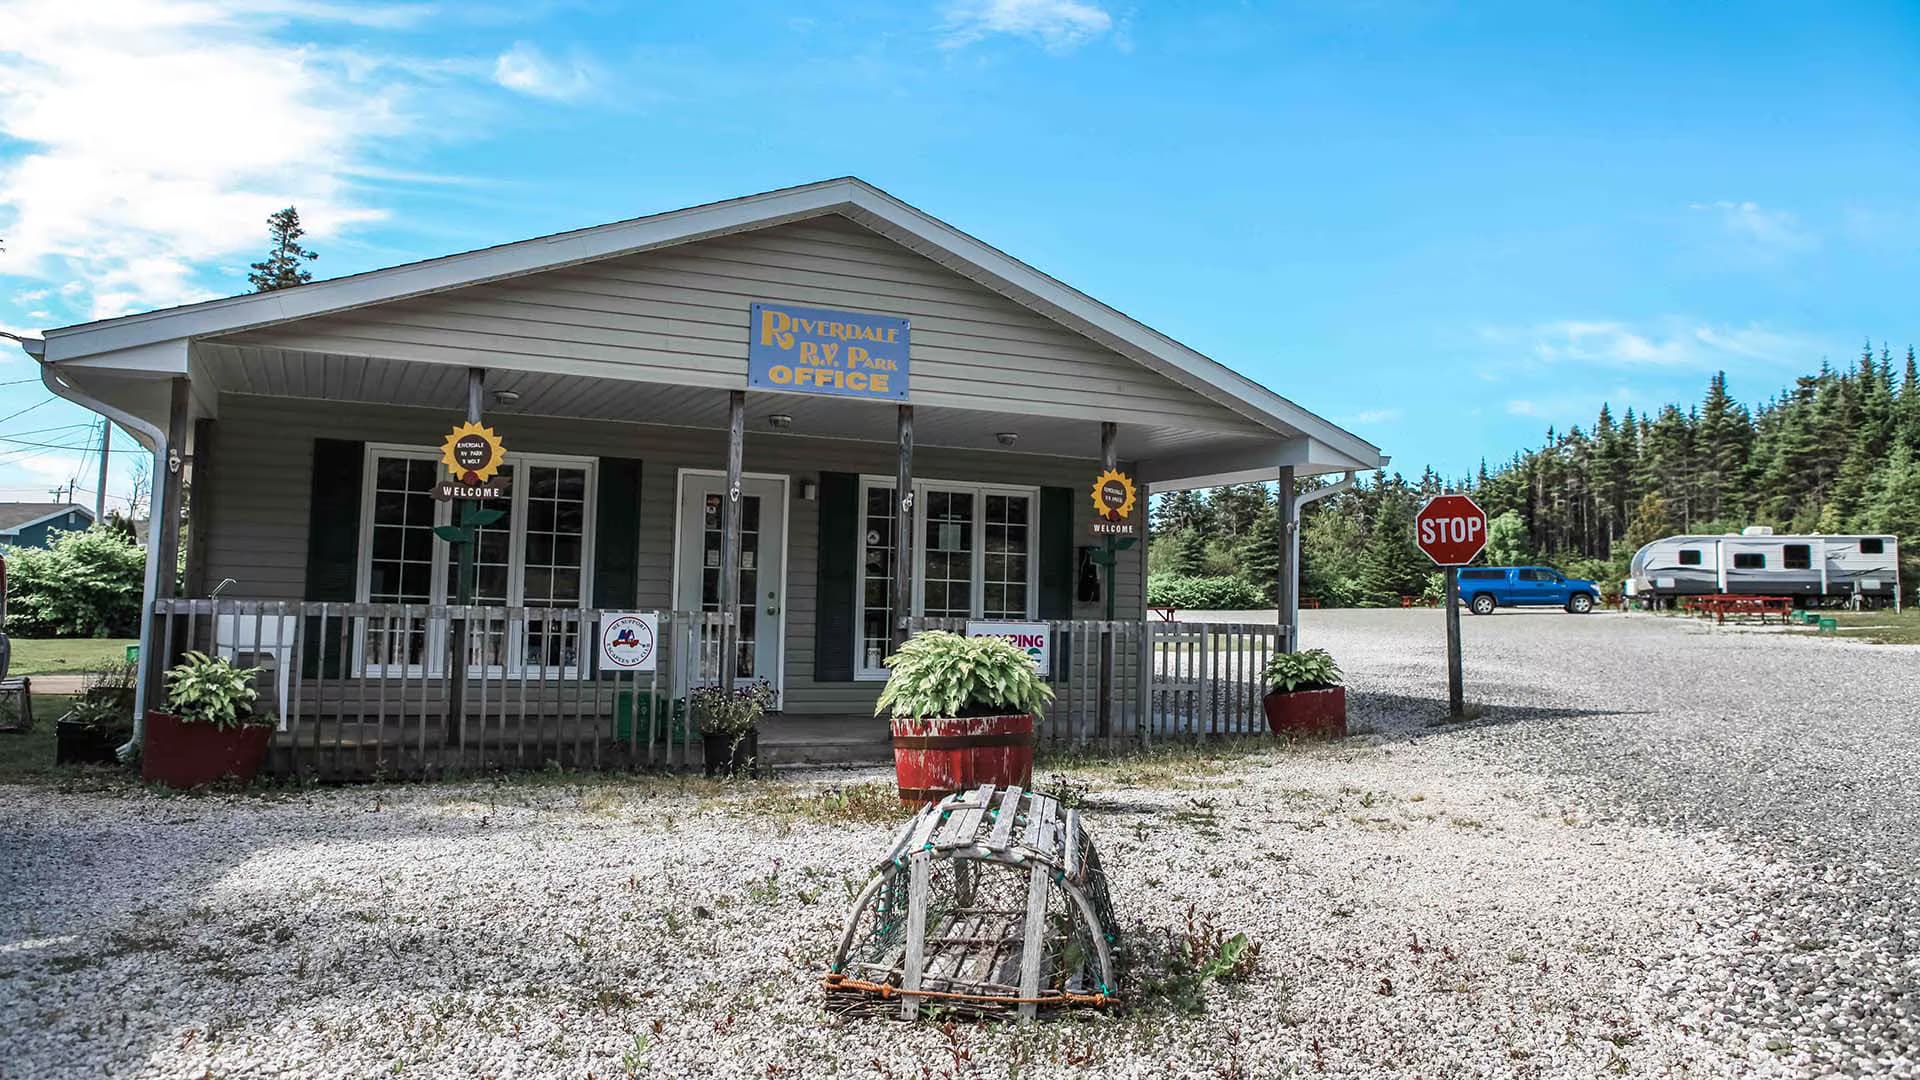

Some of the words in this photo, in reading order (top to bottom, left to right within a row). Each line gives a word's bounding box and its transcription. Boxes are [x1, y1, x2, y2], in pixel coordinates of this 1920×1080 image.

[768, 365, 889, 392] OFFICE
[443, 486, 500, 497] WELCOME
[1093, 524, 1133, 533] WELCOME
[1421, 516, 1482, 544] STOP
[974, 633, 1044, 648] PING
